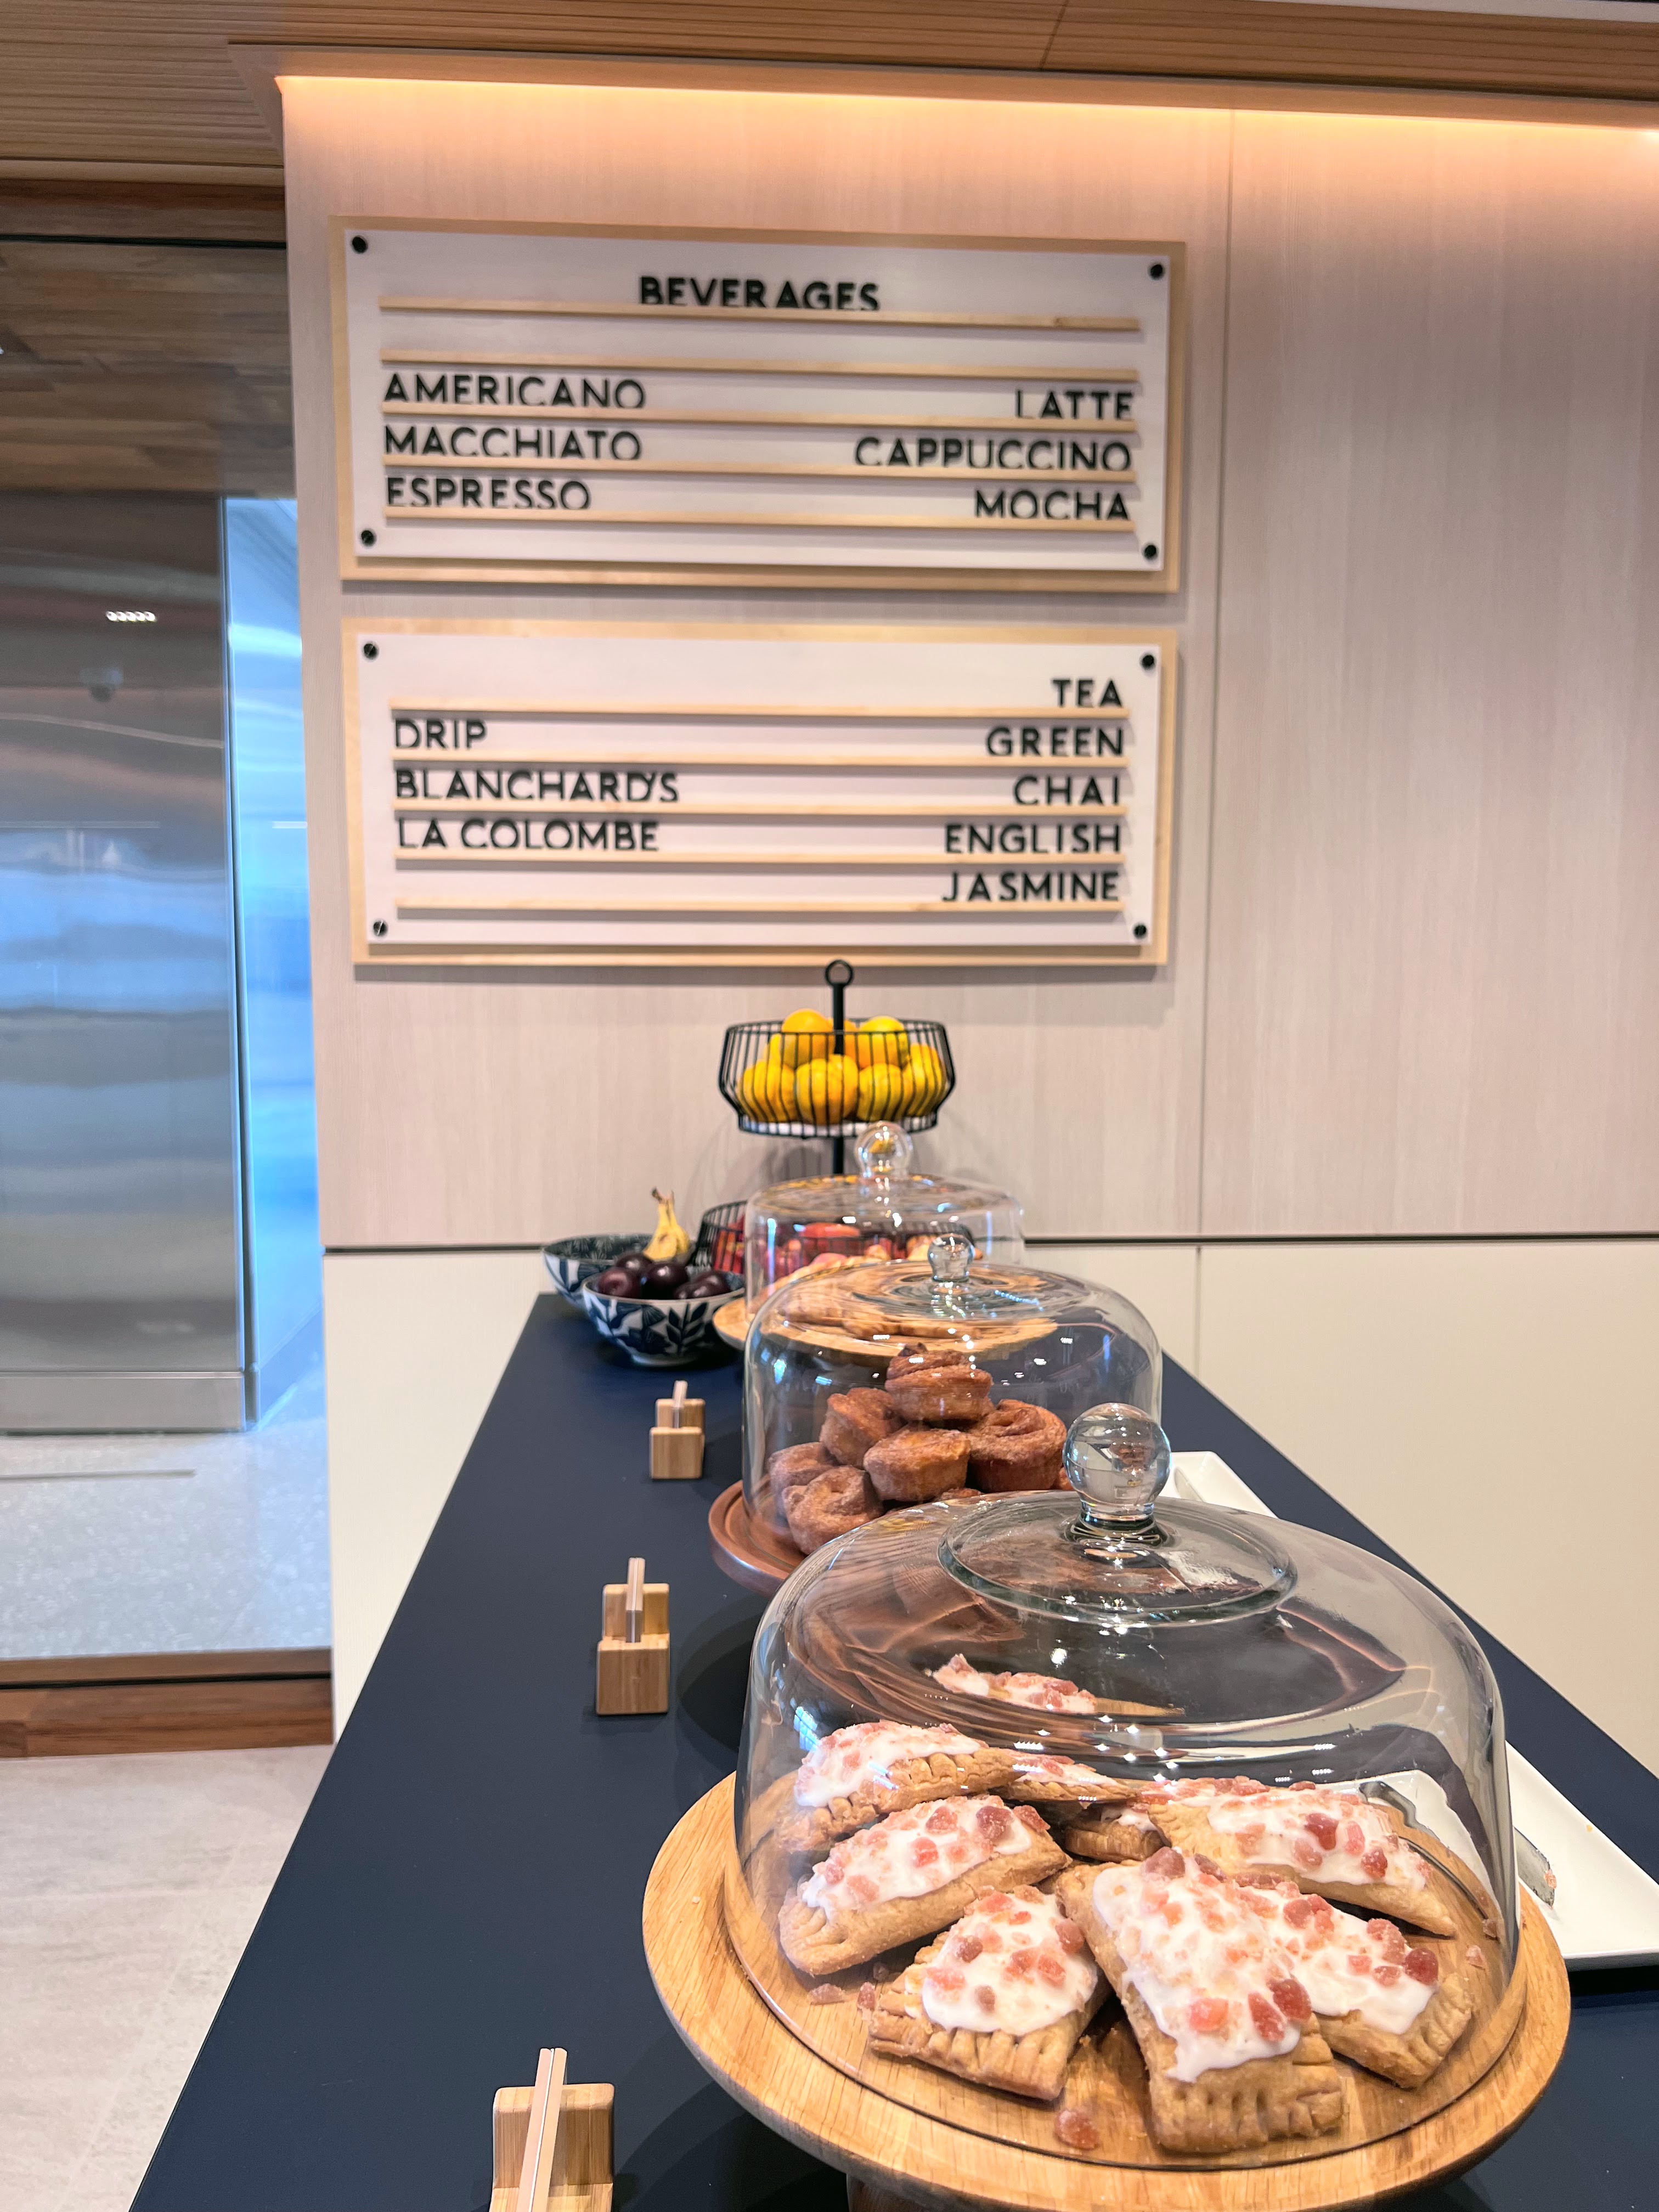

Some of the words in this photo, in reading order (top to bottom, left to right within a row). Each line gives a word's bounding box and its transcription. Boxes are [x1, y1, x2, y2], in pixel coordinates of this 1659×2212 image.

[640, 276, 880, 312] BEVERAGES
[384, 373, 645, 408] AMERICANO
[1015, 390, 1132, 420] LATTE
[384, 425, 642, 460] MACCHIATO
[855, 436, 1131, 471] CAPPUCCINO
[386, 477, 591, 510] ESPRESSO
[975, 489, 1130, 521] MOCHA
[1052, 678, 1122, 708] TEA
[394, 719, 487, 749] DRIP
[986, 727, 1122, 757] GREEN
[396, 769, 679, 802] BLANCHARD'S
[1013, 775, 1120, 805] CHAI
[399, 819, 446, 848] LA
[461, 818, 659, 851] COLOMBE
[945, 824, 1120, 854] ENGLISH
[942, 871, 1119, 901] JASMINE
